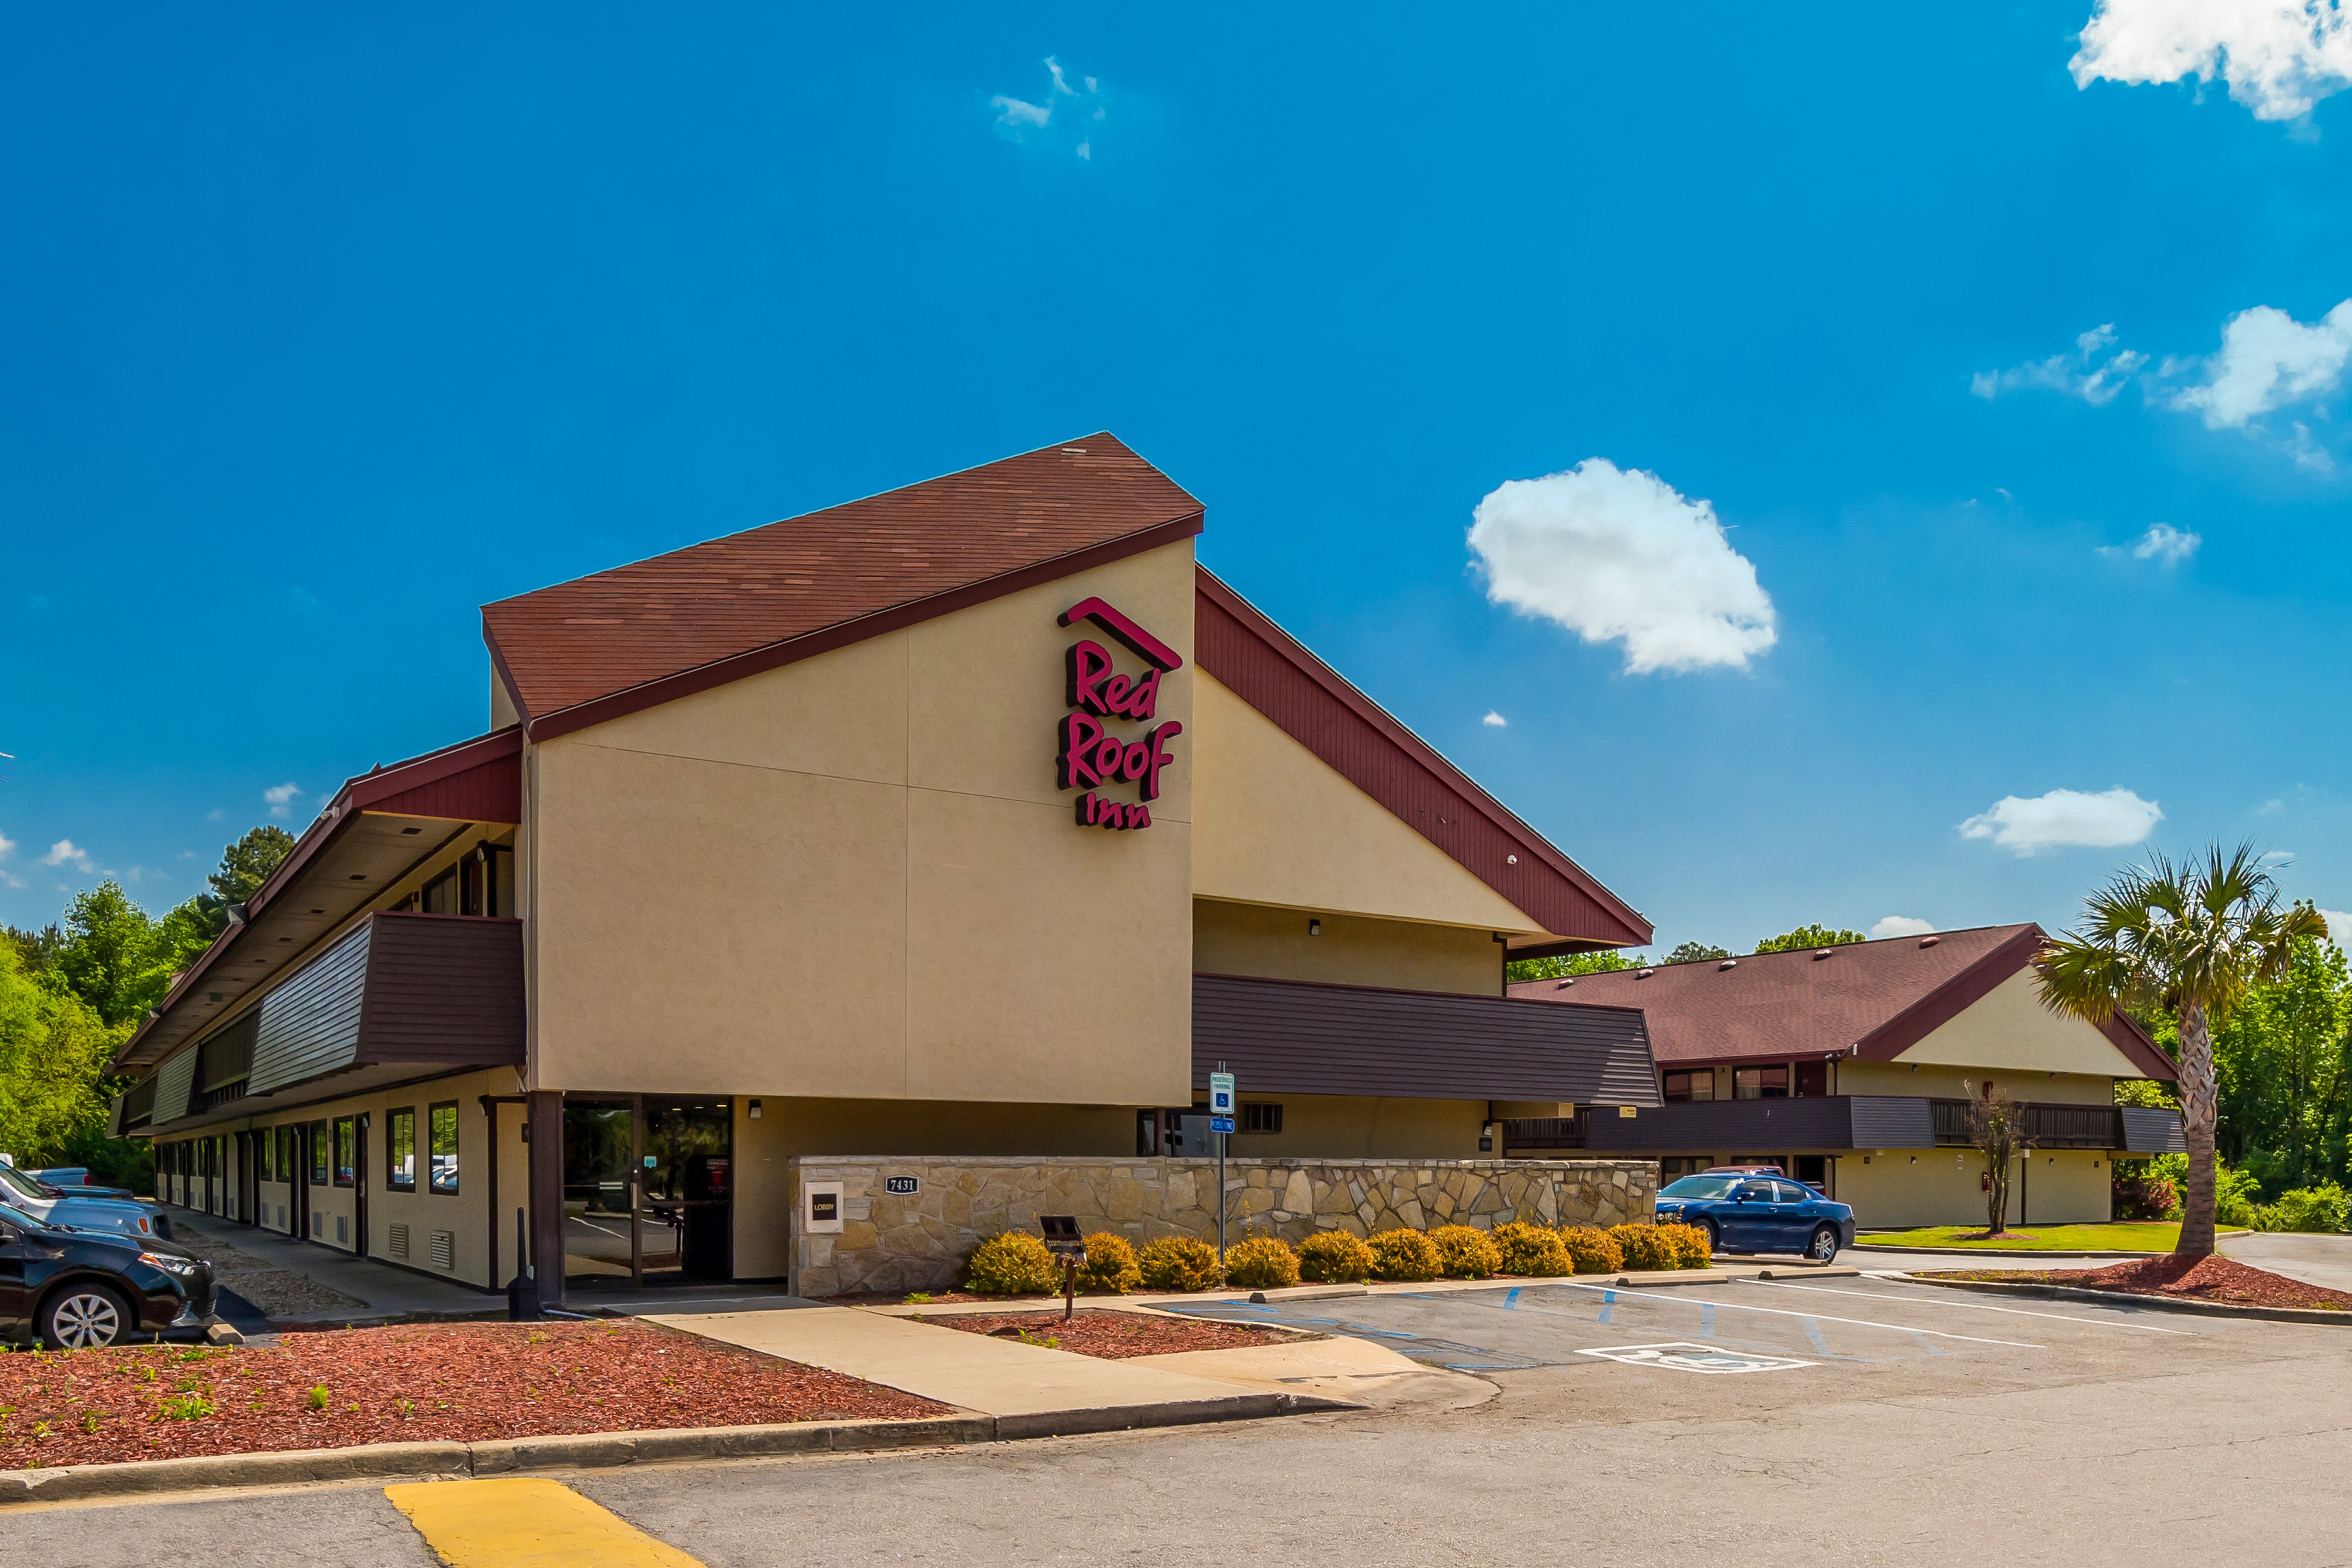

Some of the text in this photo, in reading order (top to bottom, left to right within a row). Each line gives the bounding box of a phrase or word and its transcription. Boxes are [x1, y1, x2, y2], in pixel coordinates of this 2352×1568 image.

[1075, 640, 1161, 720] Red
[1064, 712, 1182, 799] Roof
[1084, 792, 1152, 828] Inn
[891, 1180, 914, 1190] 7431
